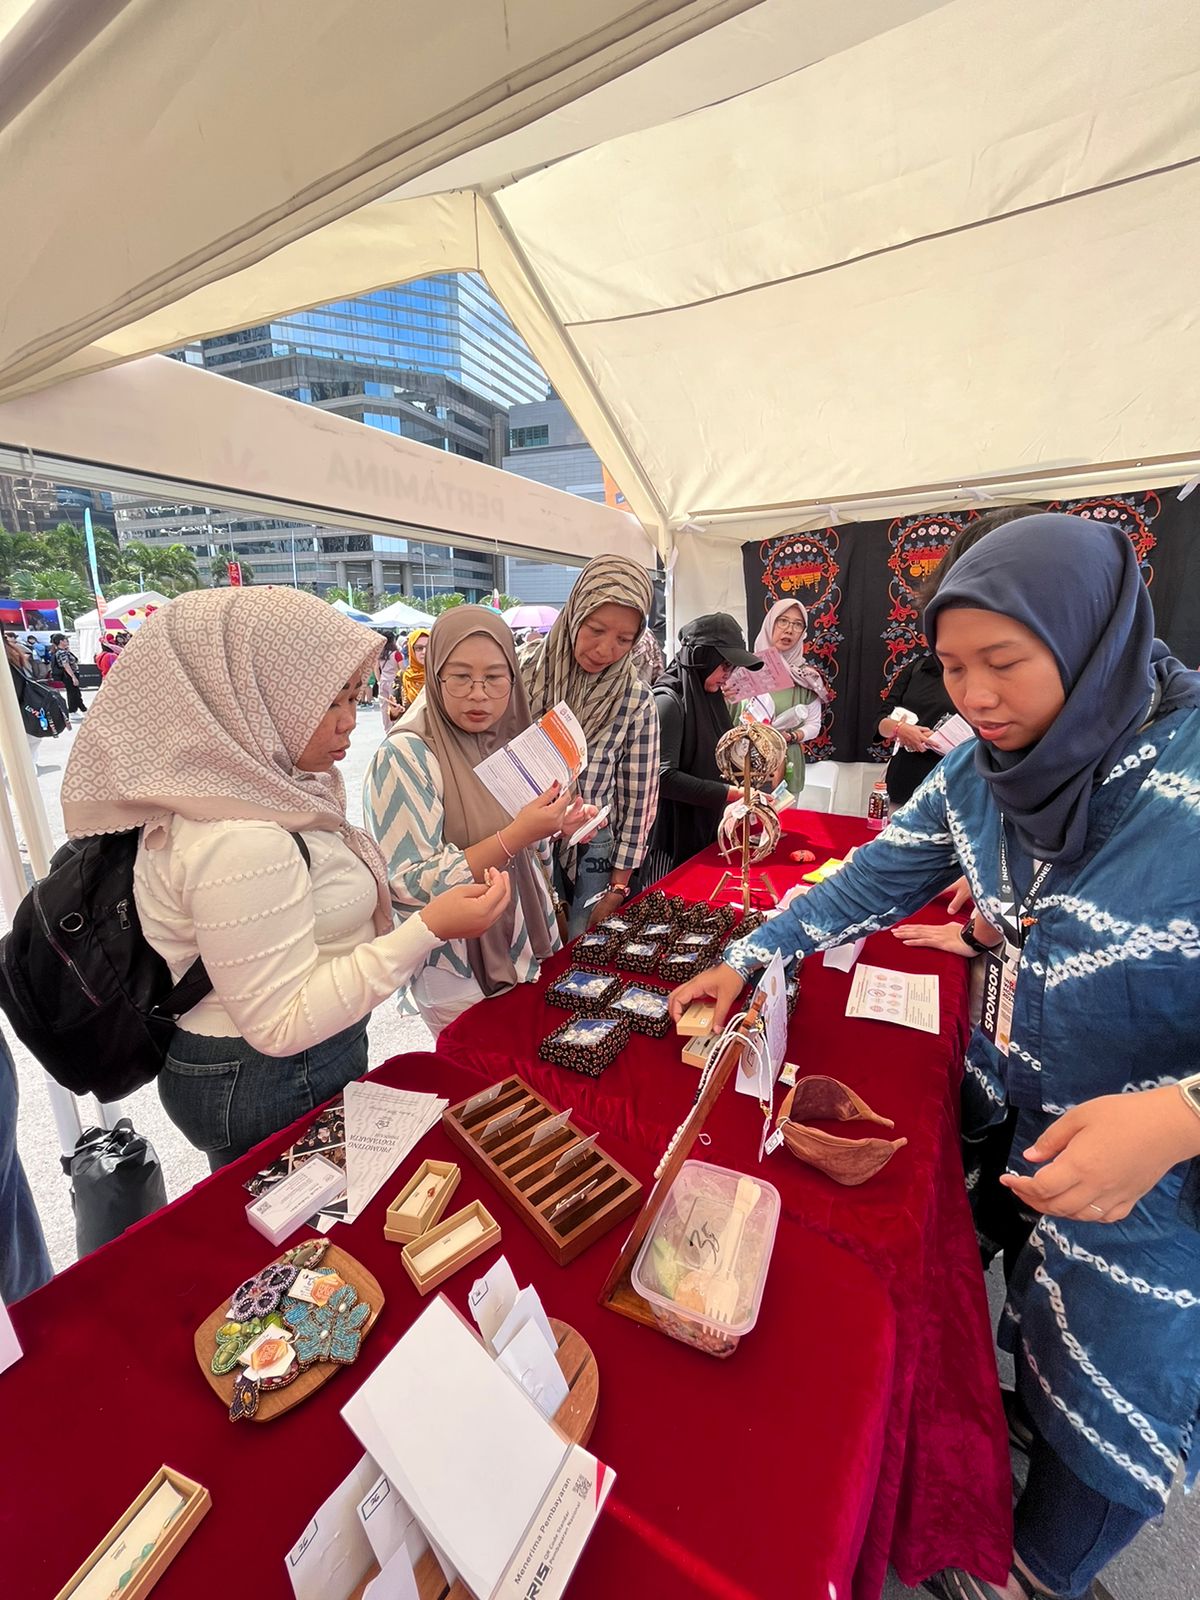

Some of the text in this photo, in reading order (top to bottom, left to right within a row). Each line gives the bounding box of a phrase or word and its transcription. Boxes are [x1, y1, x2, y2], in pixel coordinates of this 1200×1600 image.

[984, 964, 999, 1033] SPONSOR
[348, 1142, 392, 1153] PROMOTING
[350, 1134, 396, 1147] YOGYAKARTA
[514, 1477, 571, 1584] Menerima Pembayaran
[548, 1534, 559, 1550] Code
[556, 1511, 570, 1534] Standar
[549, 1501, 581, 1565] Pembayaran Nasional
